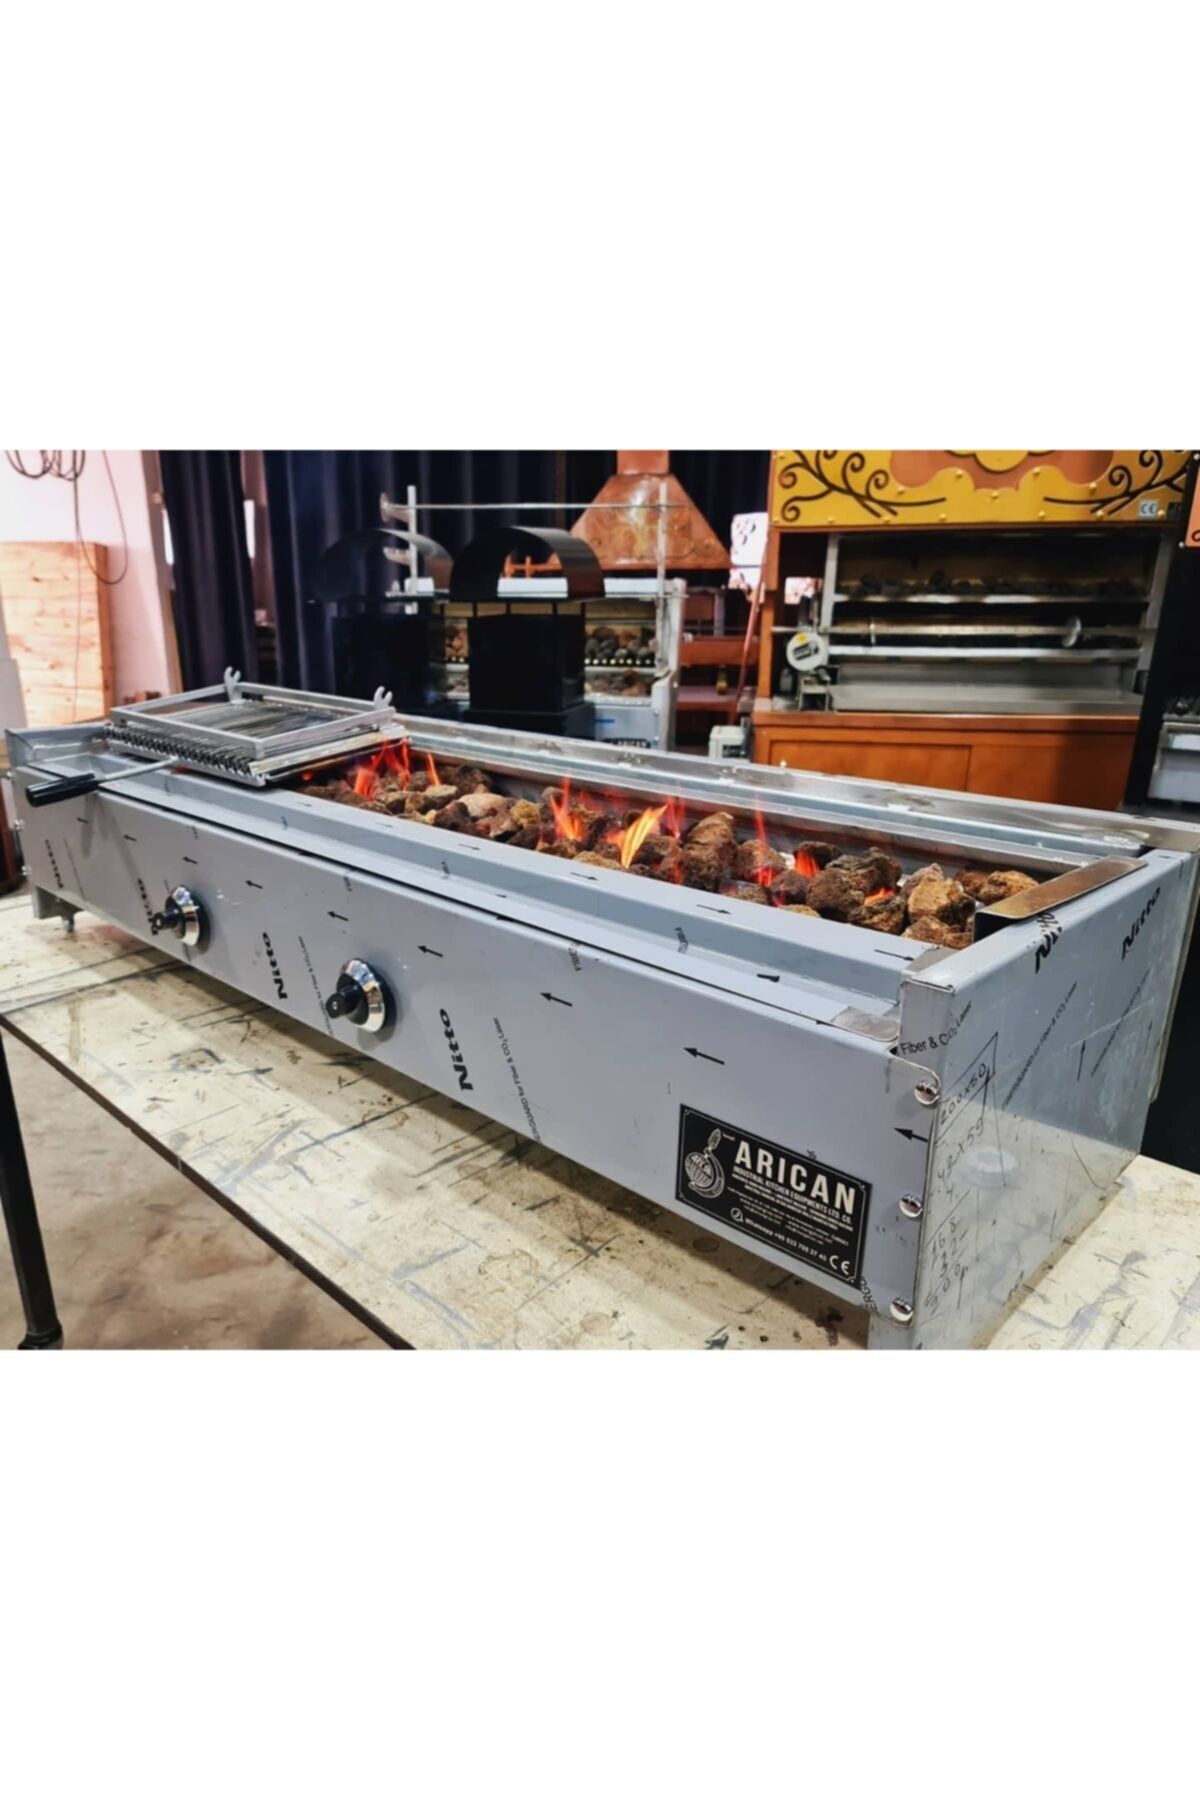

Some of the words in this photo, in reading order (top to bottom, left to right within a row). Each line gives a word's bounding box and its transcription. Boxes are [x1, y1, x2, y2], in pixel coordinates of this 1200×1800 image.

[1122, 886, 1161, 961] Nitto
[262, 932, 288, 1000] Nitto
[440, 1008, 474, 1091] Nitto
[492, 1016, 505, 1039] Laser
[900, 1041, 927, 1055] Fiber
[928, 1037, 938, 1049] &
[735, 1140, 856, 1215] ARICAN
[790, 1191, 828, 1214] EQUIPMENTS
[829, 1254, 850, 1275] CE
